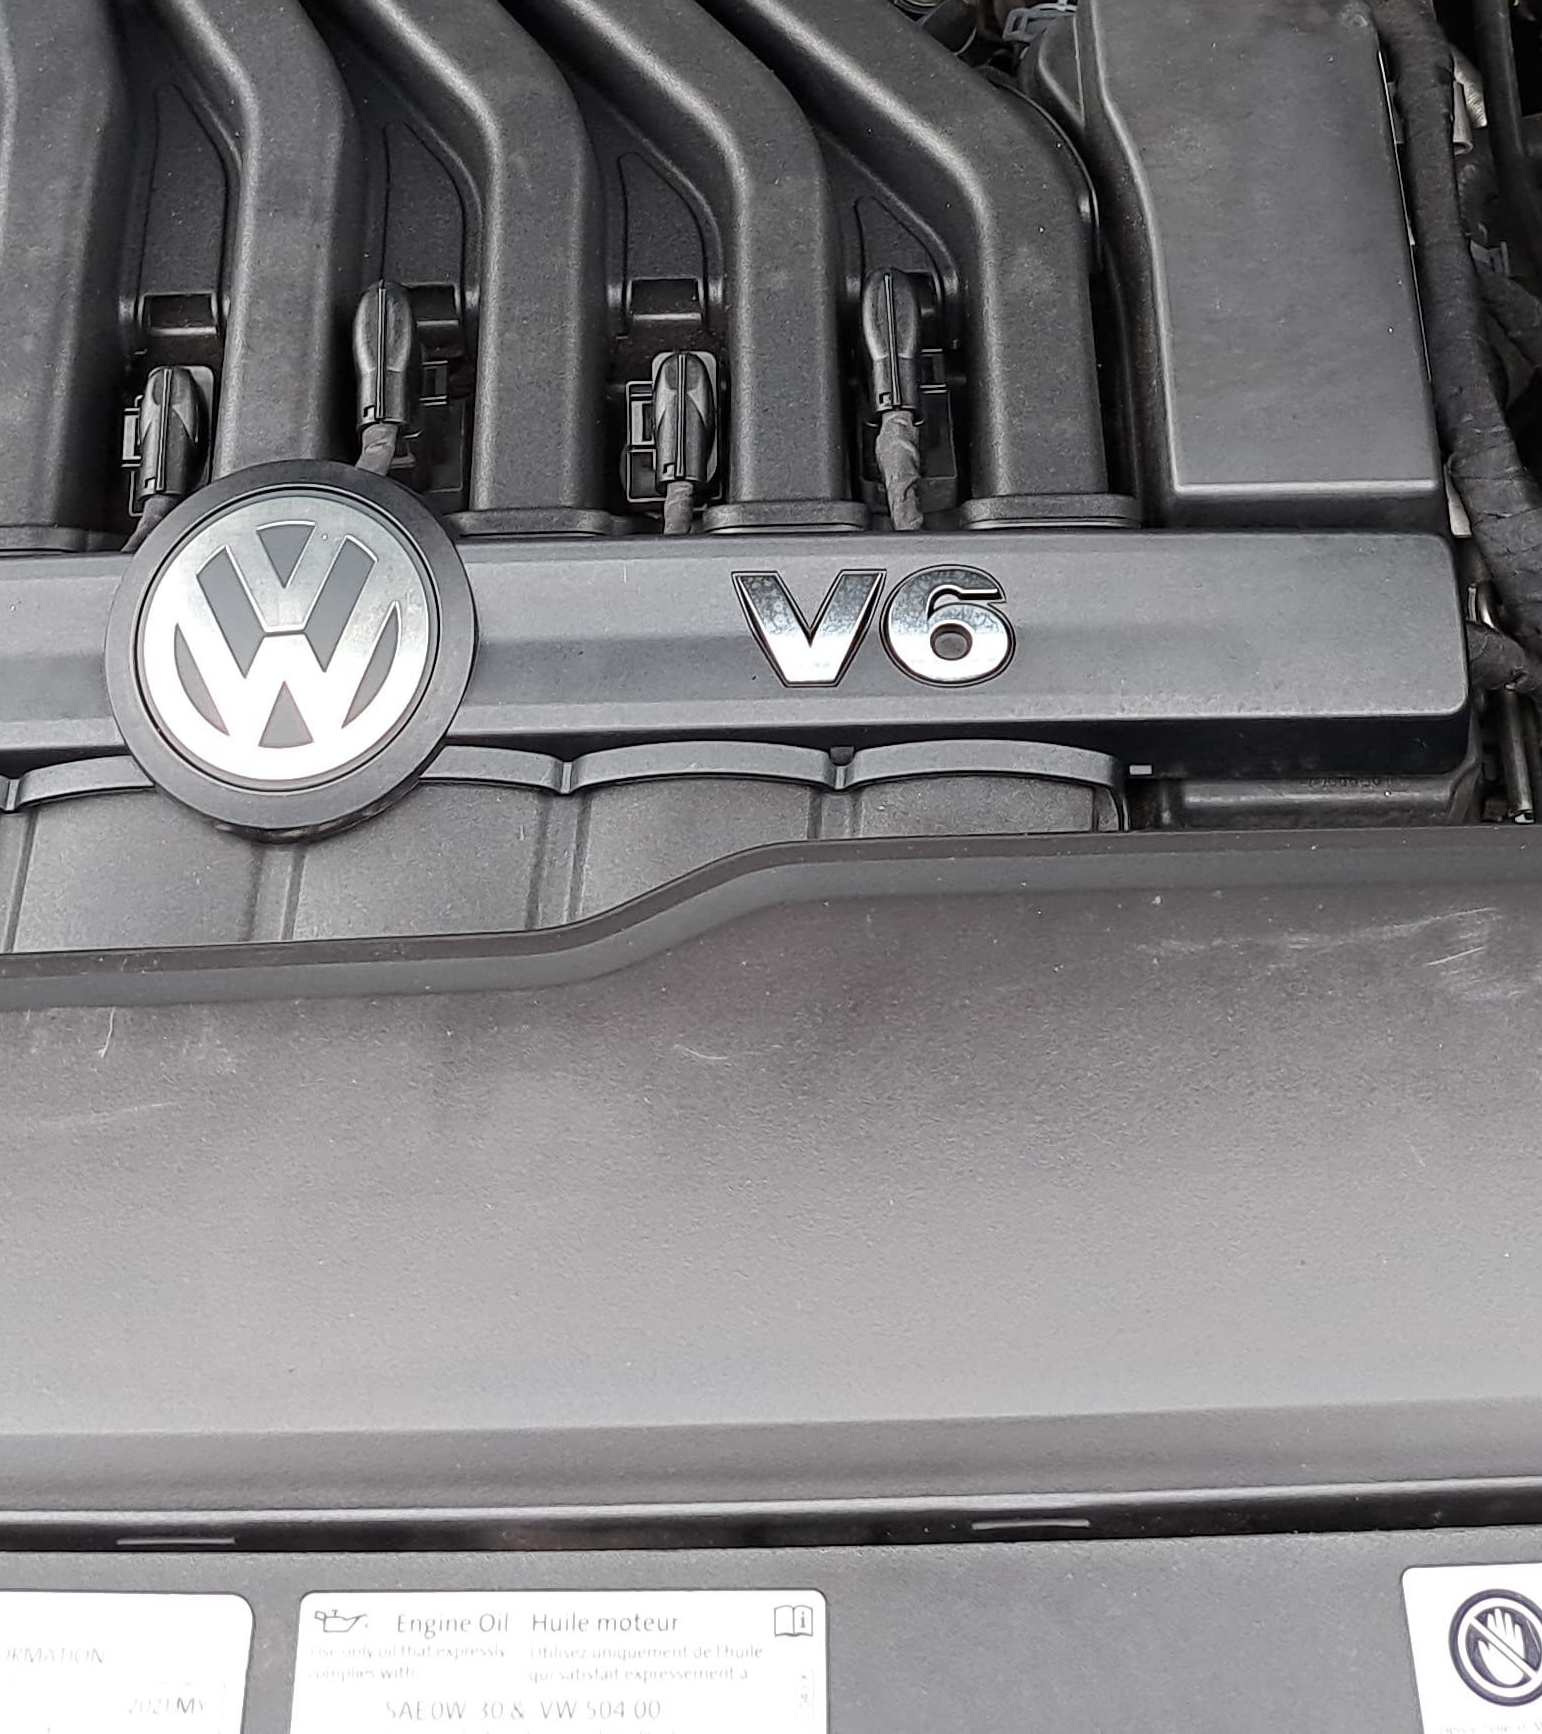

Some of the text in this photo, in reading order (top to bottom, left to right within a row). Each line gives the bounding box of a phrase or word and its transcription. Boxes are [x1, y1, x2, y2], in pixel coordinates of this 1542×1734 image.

[732, 563, 1017, 690] V6
[397, 1612, 509, 1640] Engine Oil
[531, 1612, 679, 1633] Huile moteur
[693, 1643, 712, 1659] de
[539, 1699, 579, 1721] VW
[586, 1699, 626, 1721] 504
[633, 1700, 662, 1721] 00
